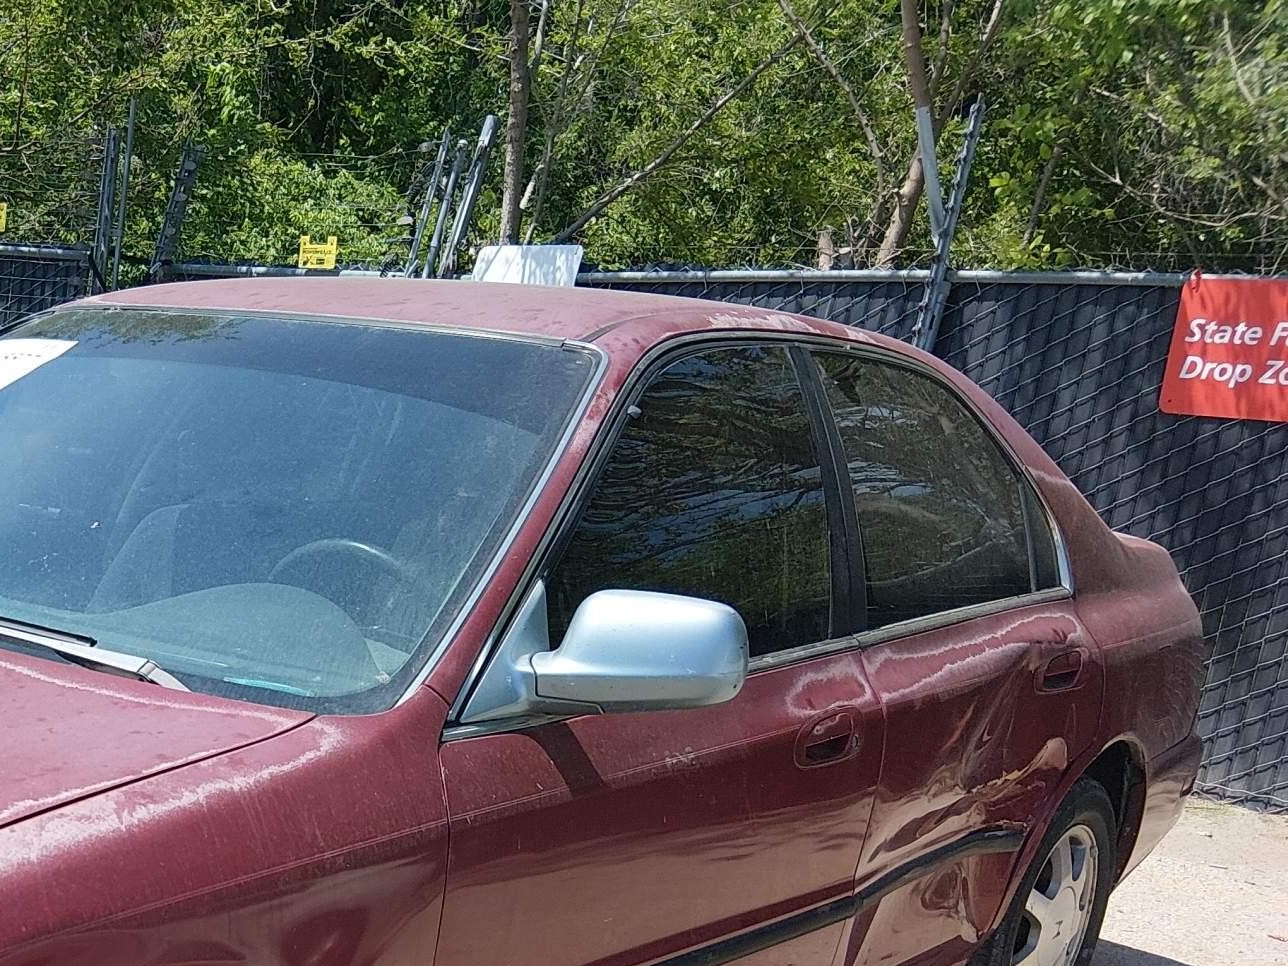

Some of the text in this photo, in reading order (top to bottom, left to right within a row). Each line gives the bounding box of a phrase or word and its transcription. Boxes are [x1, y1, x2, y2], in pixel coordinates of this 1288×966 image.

[1184, 318, 1288, 347] State F
[1178, 355, 1253, 389] Drop
